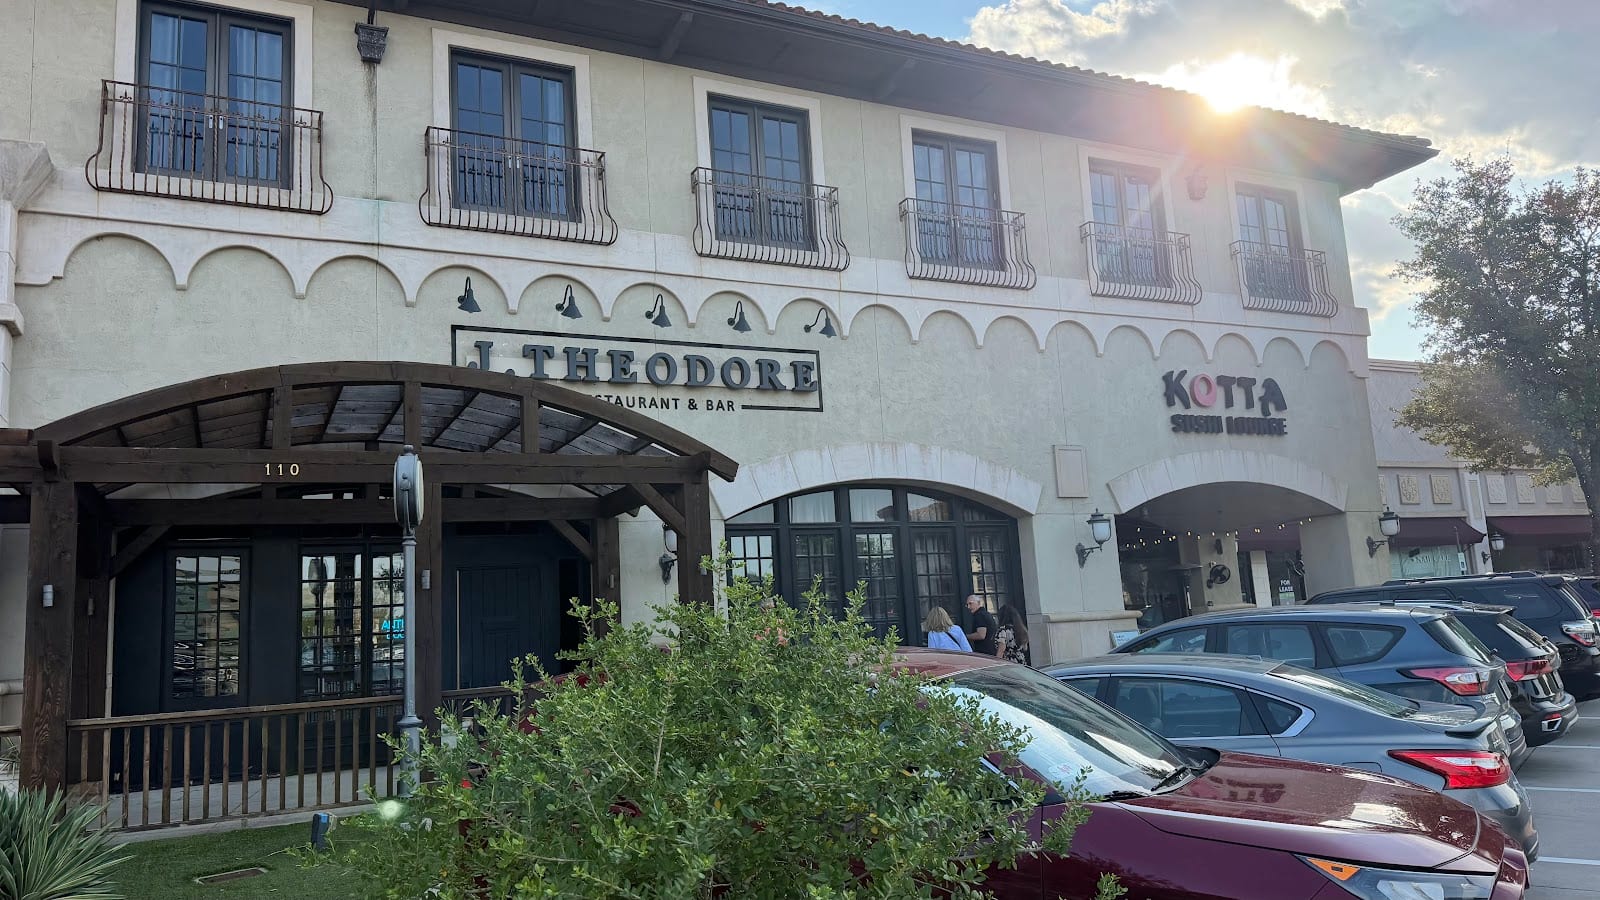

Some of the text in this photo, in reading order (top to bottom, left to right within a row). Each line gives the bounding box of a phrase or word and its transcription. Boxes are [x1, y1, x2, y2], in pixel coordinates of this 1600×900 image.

[522, 344, 818, 392] THEODORE
[1162, 370, 1288, 416] KOTTA
[687, 398, 699, 411] &
[705, 400, 735, 411] BAR
[1170, 414, 1224, 433] SUSHI
[264, 463, 300, 476] 110
